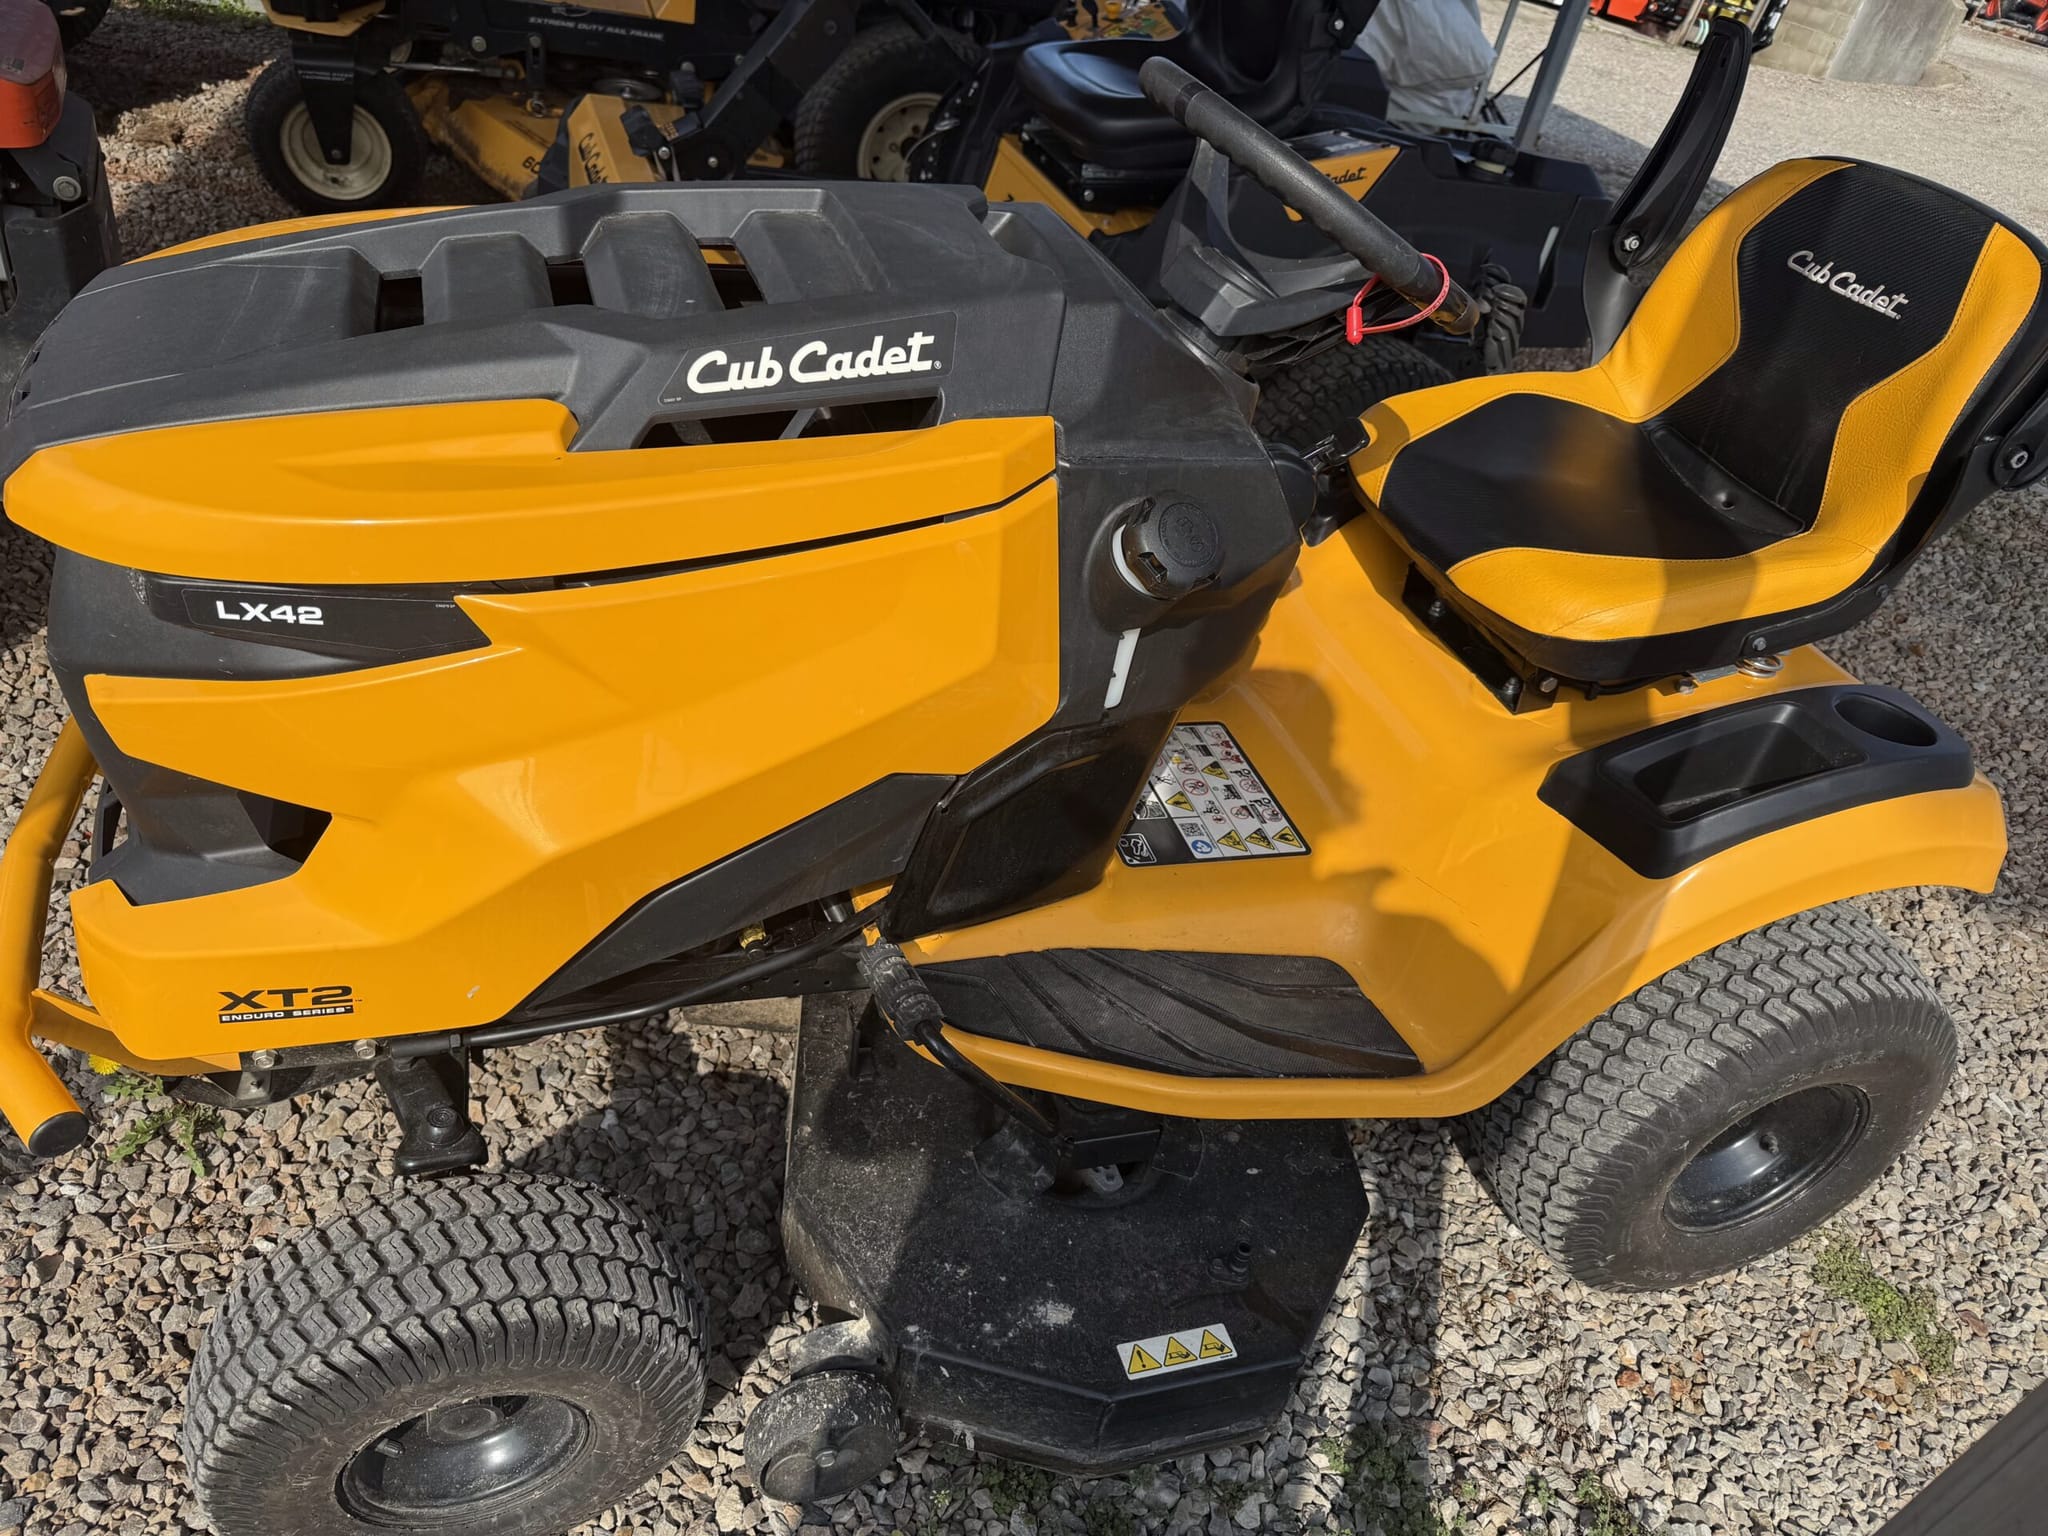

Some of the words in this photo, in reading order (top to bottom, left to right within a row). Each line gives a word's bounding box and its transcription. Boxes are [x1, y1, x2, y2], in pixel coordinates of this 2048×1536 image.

[528, 16, 576, 28] EXTREME
[577, 22, 604, 32] DUTY
[606, 26, 627, 36] RAIL
[629, 30, 664, 41] FRAME
[1325, 167, 1368, 185] adet
[1787, 250, 1834, 284] Cub
[1828, 271, 1909, 319] Cadet
[686, 346, 783, 394] Cub
[788, 331, 935, 384] Cadet
[215, 600, 324, 626] LX42
[218, 985, 353, 1012] XT2
[220, 1011, 285, 1022] ENDURO
[292, 1006, 346, 1017] SERIES
